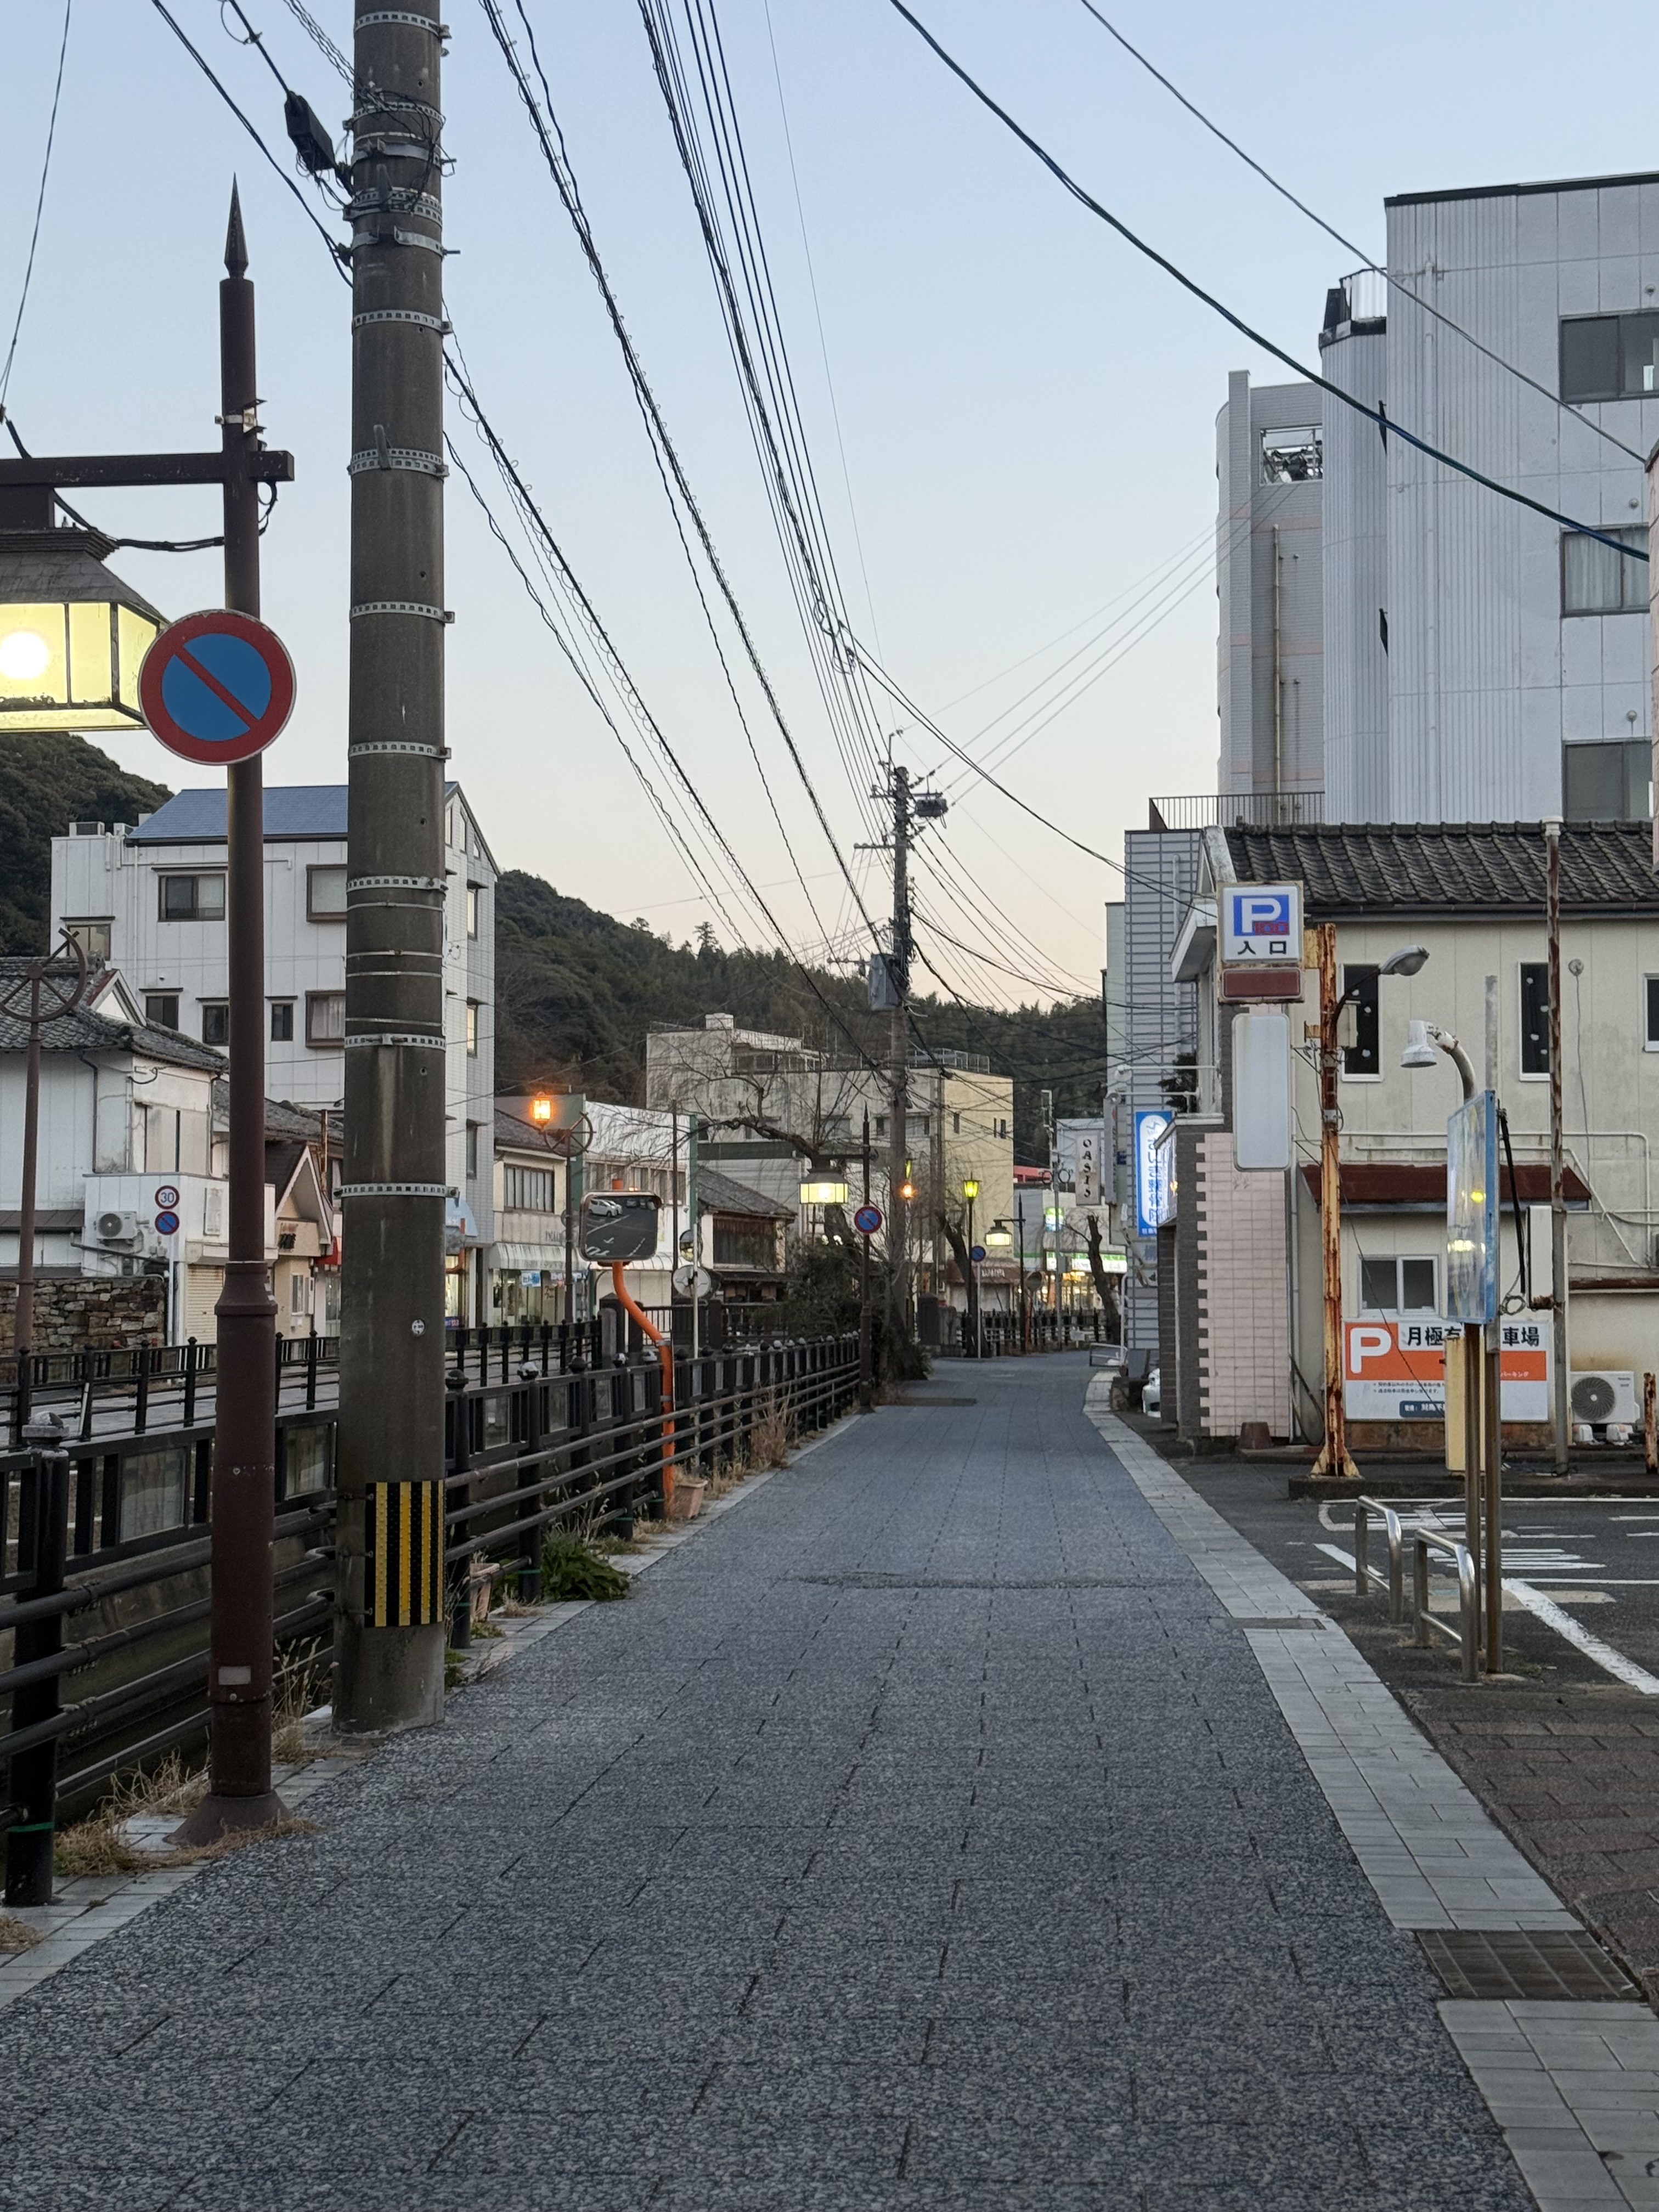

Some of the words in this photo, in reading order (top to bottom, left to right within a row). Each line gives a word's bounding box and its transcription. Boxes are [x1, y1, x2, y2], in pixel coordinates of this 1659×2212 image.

[1241, 898, 1282, 933] P
[1238, 940, 1287, 955] 入口
[1082, 1139, 1092, 1198] OASIS
[160, 1192, 174, 1203] 30
[1350, 1327, 1392, 1374] P
